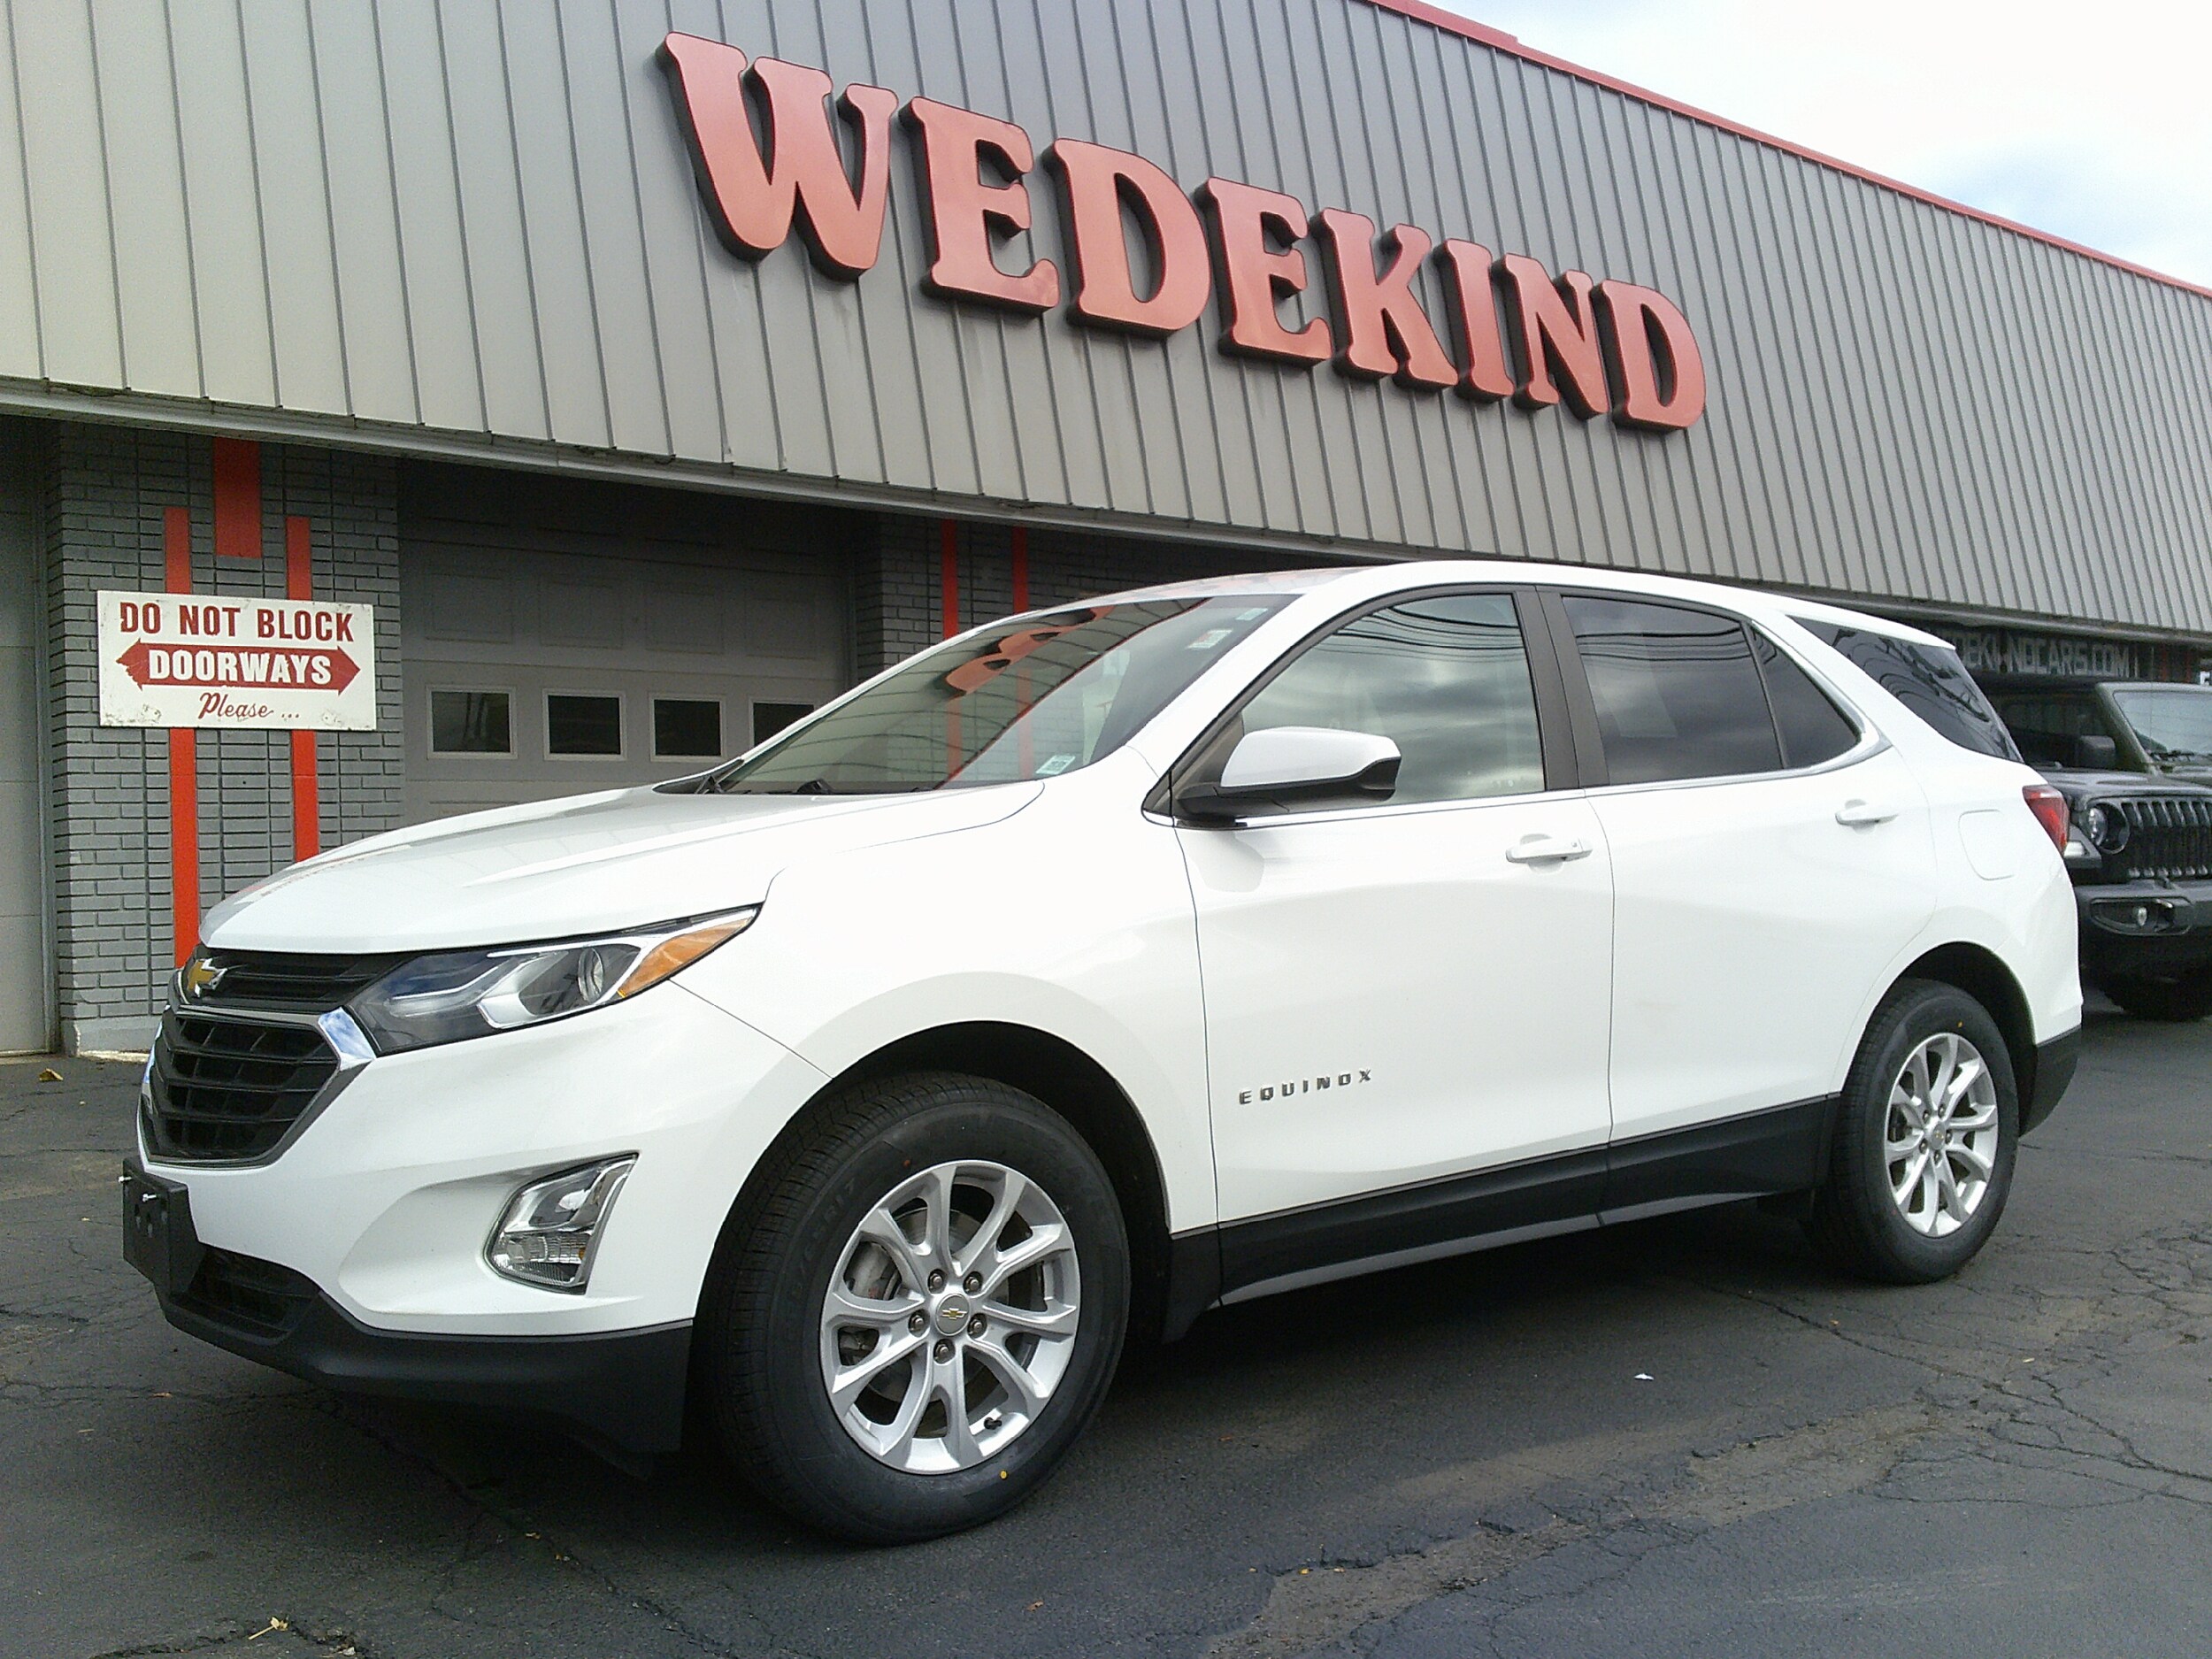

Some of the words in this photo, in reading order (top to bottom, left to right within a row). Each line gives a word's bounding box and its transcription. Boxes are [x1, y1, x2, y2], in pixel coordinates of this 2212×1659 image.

[657, 31, 1707, 432] WEDEKIND
[120, 602, 161, 634] DO
[179, 604, 241, 637] NOT
[257, 608, 354, 642] BLOCK
[149, 649, 332, 685] DOORWAYS
[1239, 1069, 1371, 1105] EQUINOX
